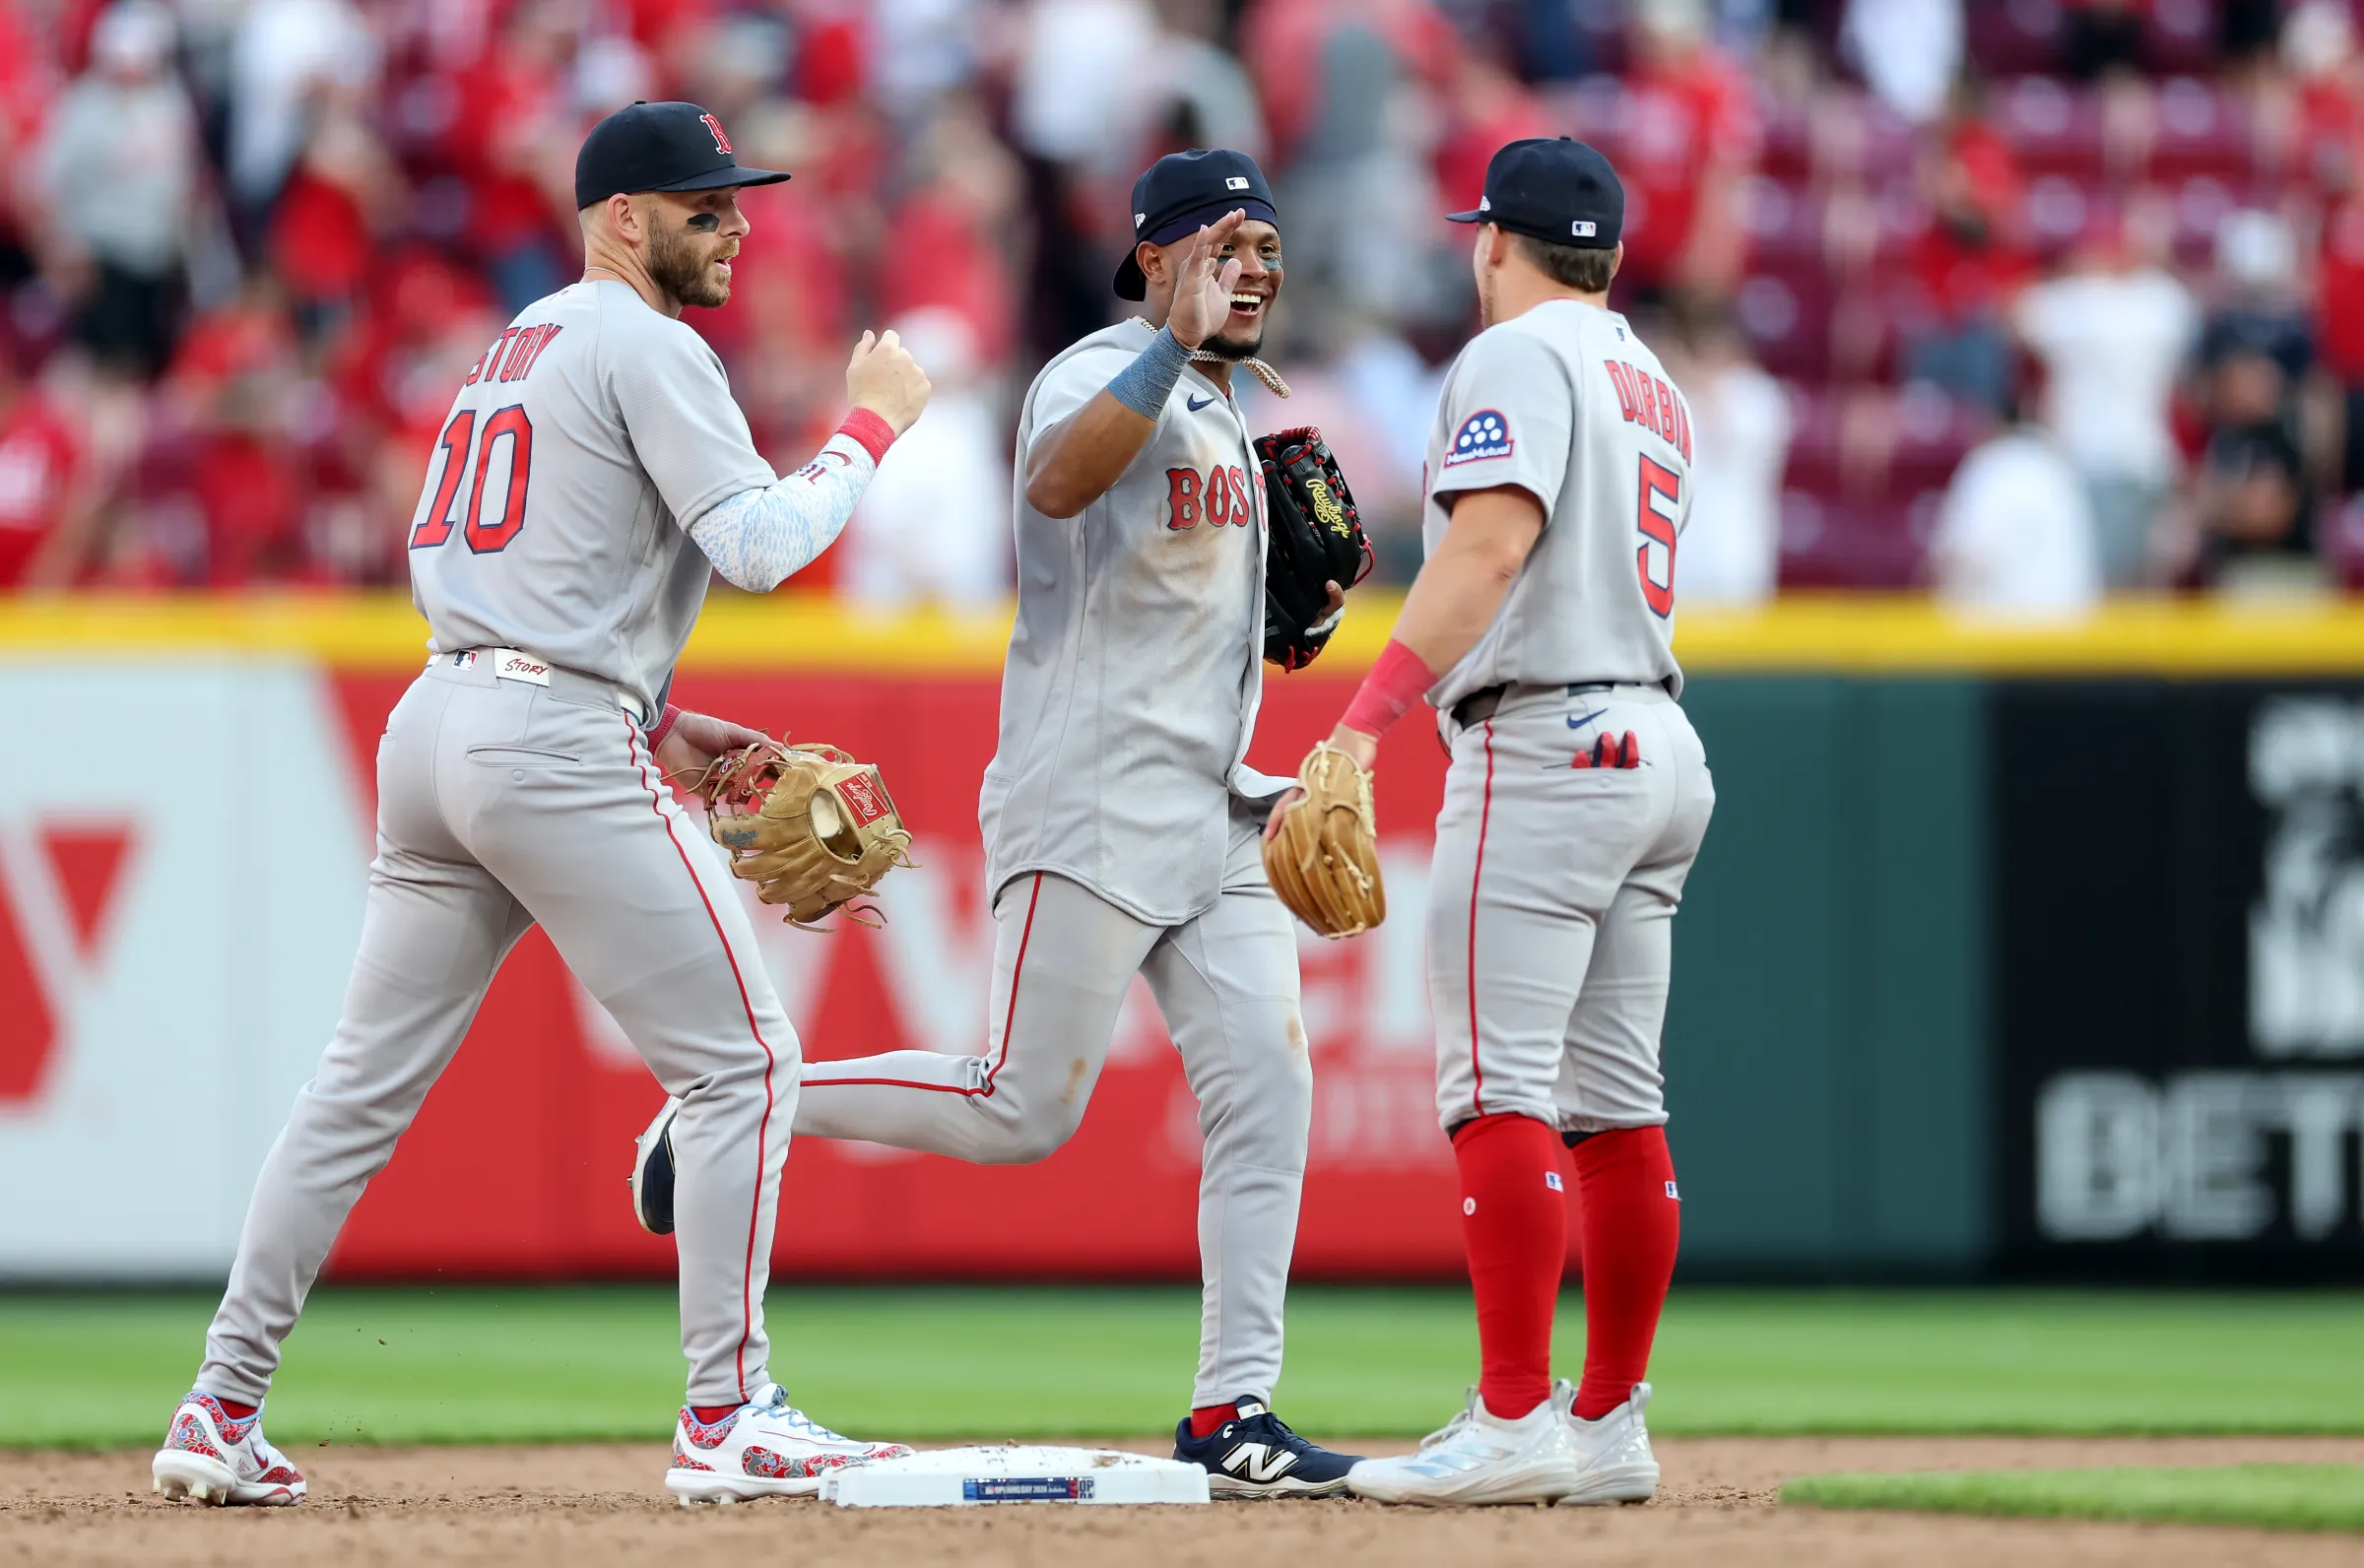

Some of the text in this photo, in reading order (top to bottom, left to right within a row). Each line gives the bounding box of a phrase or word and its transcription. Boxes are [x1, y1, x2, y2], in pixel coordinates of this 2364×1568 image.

[699, 113, 733, 155] B
[1604, 359, 1692, 468] DURBIN
[409, 403, 533, 555] 10
[1305, 479, 1350, 539] Rawlings
[1637, 451, 1679, 621] 5
[504, 658, 548, 676] STORY
[847, 782, 878, 817] Rawlings
[2035, 1070, 2364, 1241] BET
[1221, 1442, 1298, 1481] N
